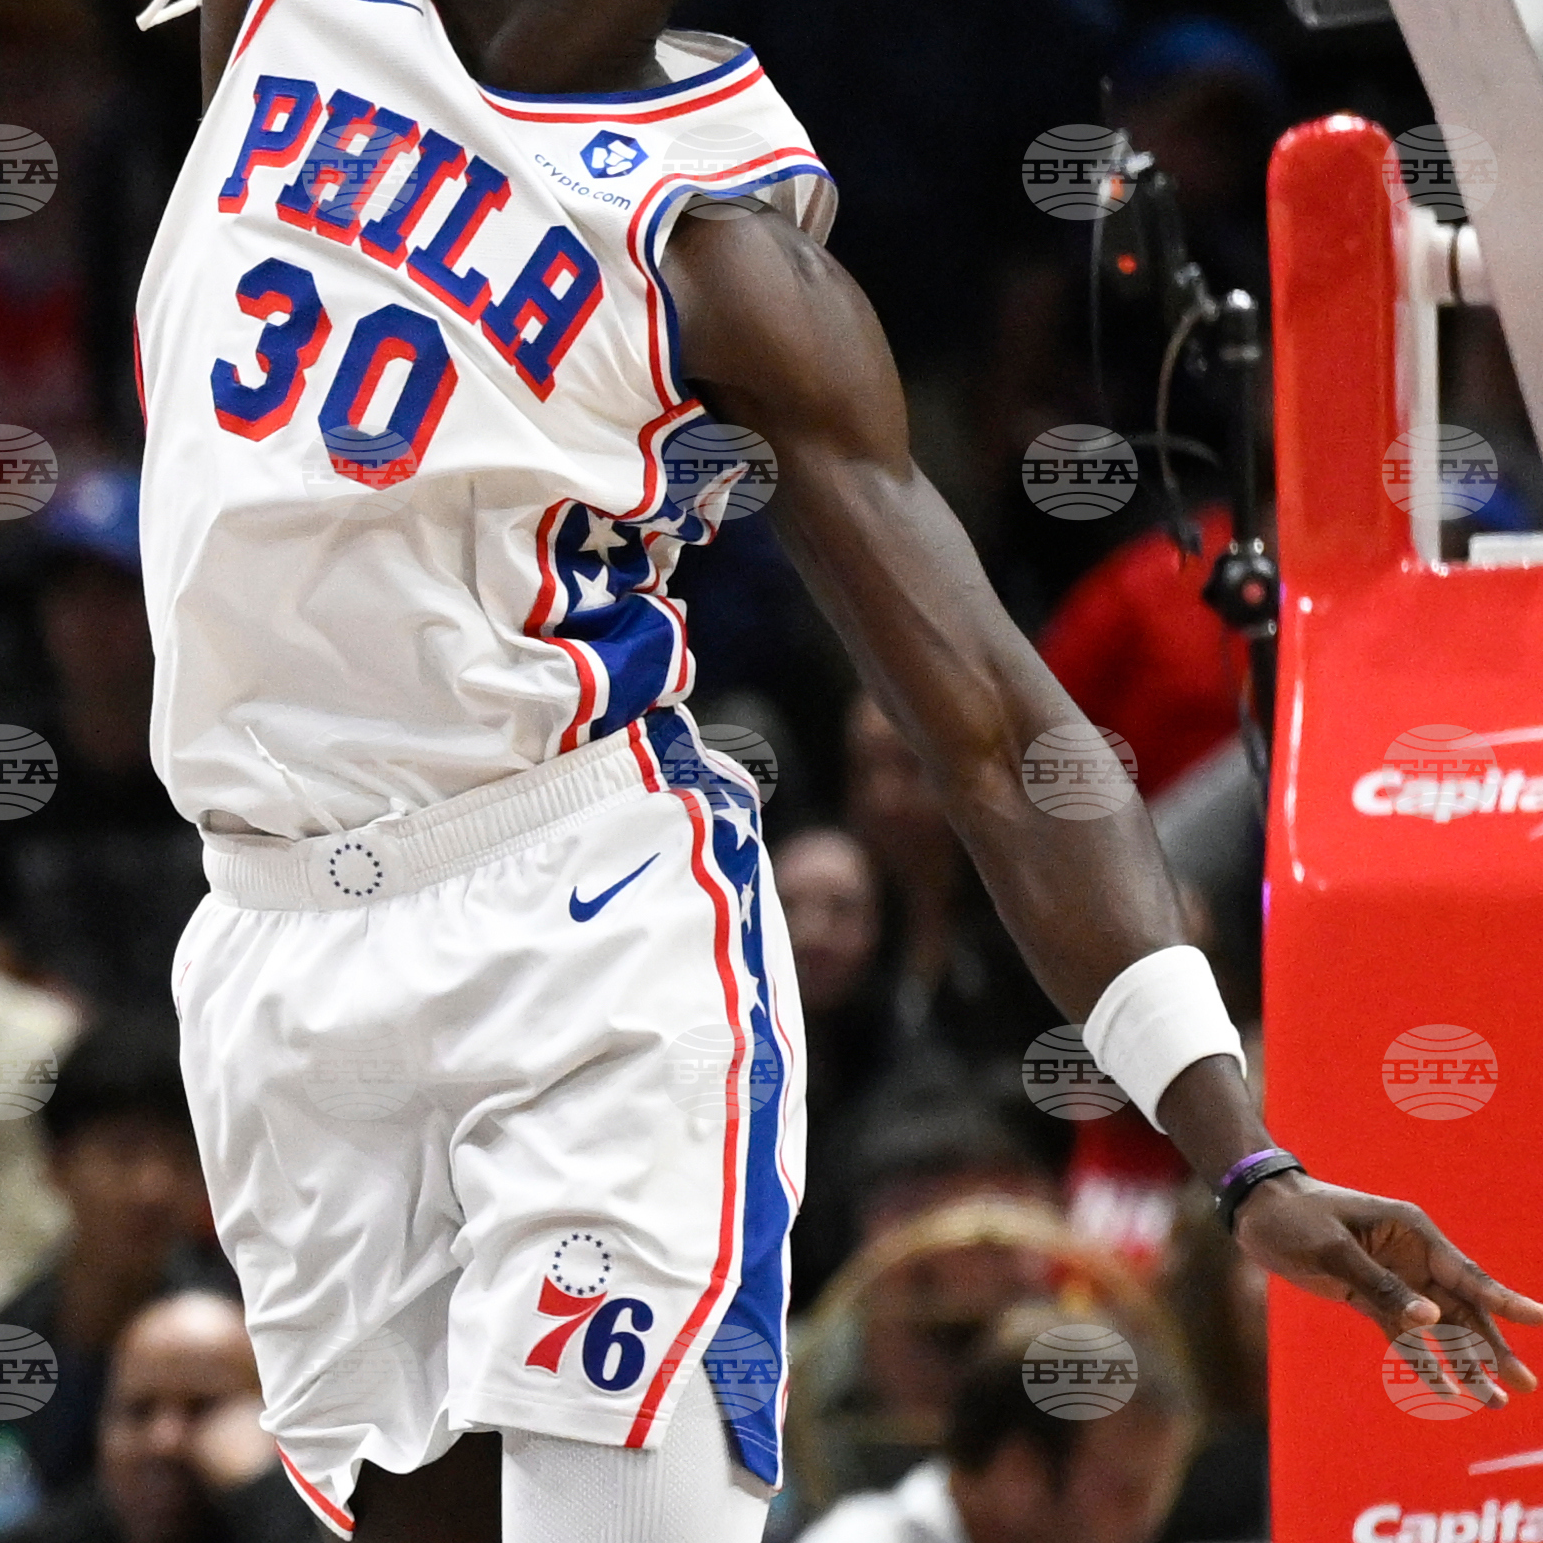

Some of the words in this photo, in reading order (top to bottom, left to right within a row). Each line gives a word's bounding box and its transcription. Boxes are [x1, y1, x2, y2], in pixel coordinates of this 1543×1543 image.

[218, 74, 605, 402] PHILA
[534, 153, 632, 210] crypto.com
[210, 258, 459, 491] 30
[524, 1273, 655, 1394] 76
